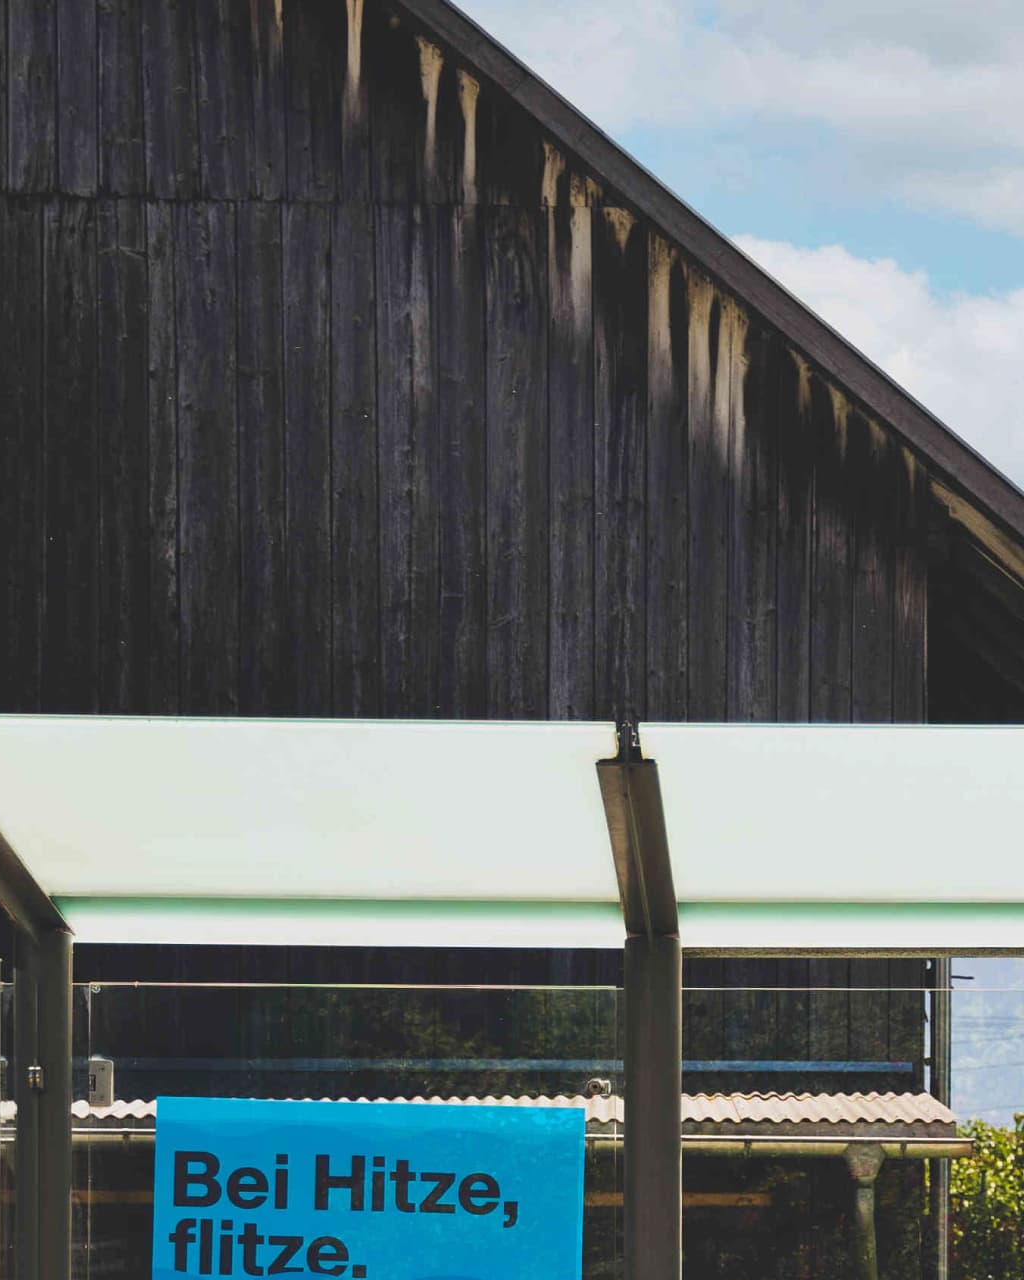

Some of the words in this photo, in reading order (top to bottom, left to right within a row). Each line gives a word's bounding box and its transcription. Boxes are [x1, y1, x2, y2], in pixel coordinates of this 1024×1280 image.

[173, 1150, 288, 1209] Bei
[314, 1153, 519, 1228] Hitze,
[169, 1218, 367, 1278] flitze.
